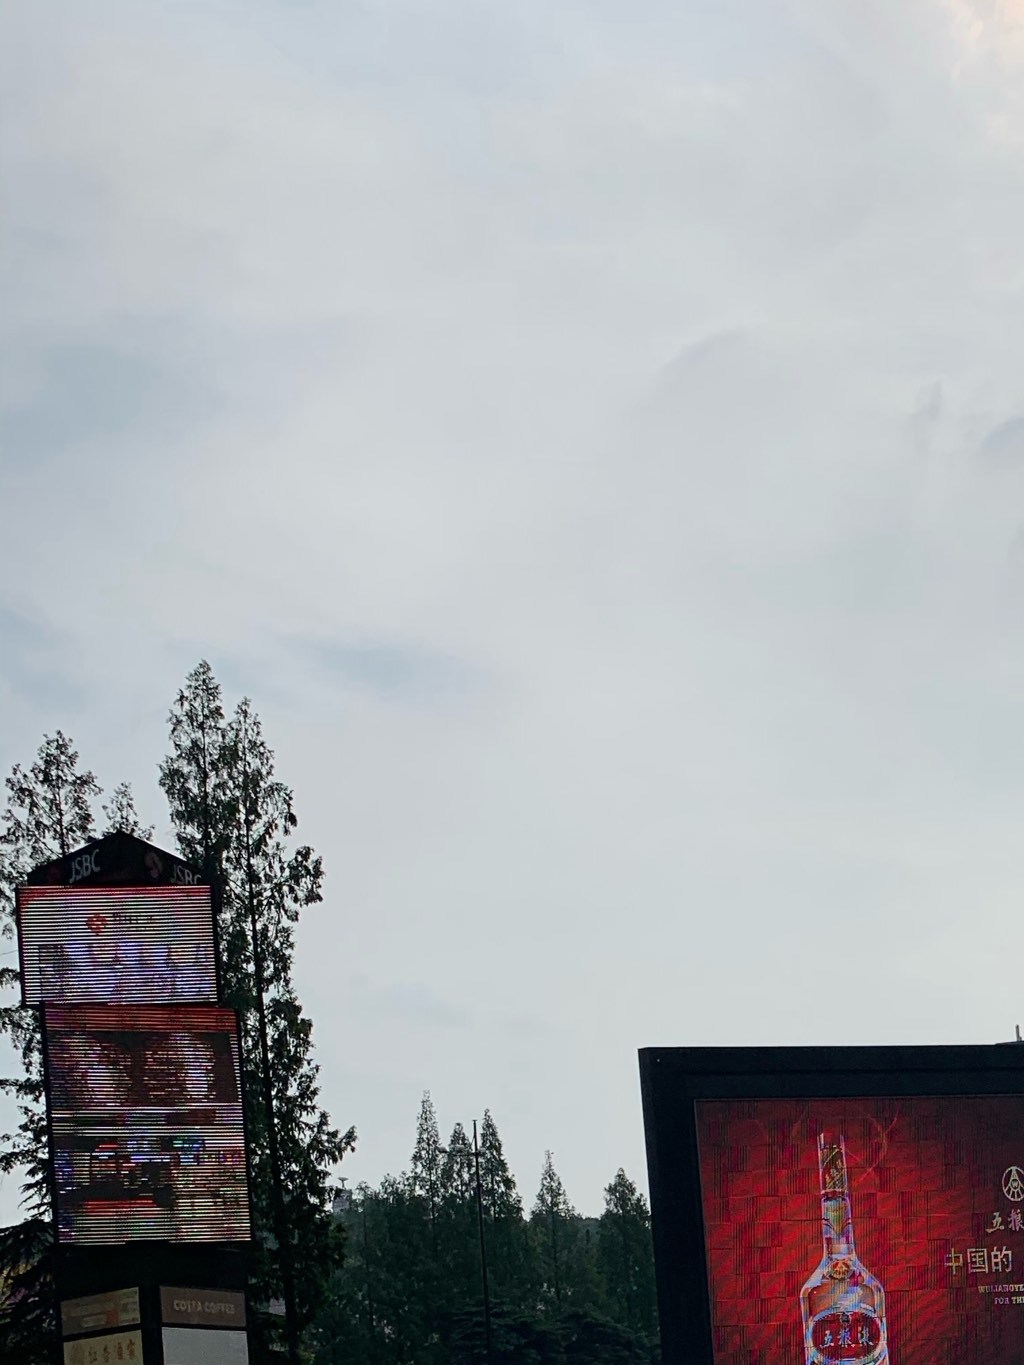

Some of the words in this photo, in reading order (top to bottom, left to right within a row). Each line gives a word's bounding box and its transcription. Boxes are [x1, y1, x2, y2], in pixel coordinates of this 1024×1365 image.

[69, 849, 101, 884] JSBC
[944, 1246, 1012, 1275] 中国的
[994, 1297, 1010, 1305] FOR
